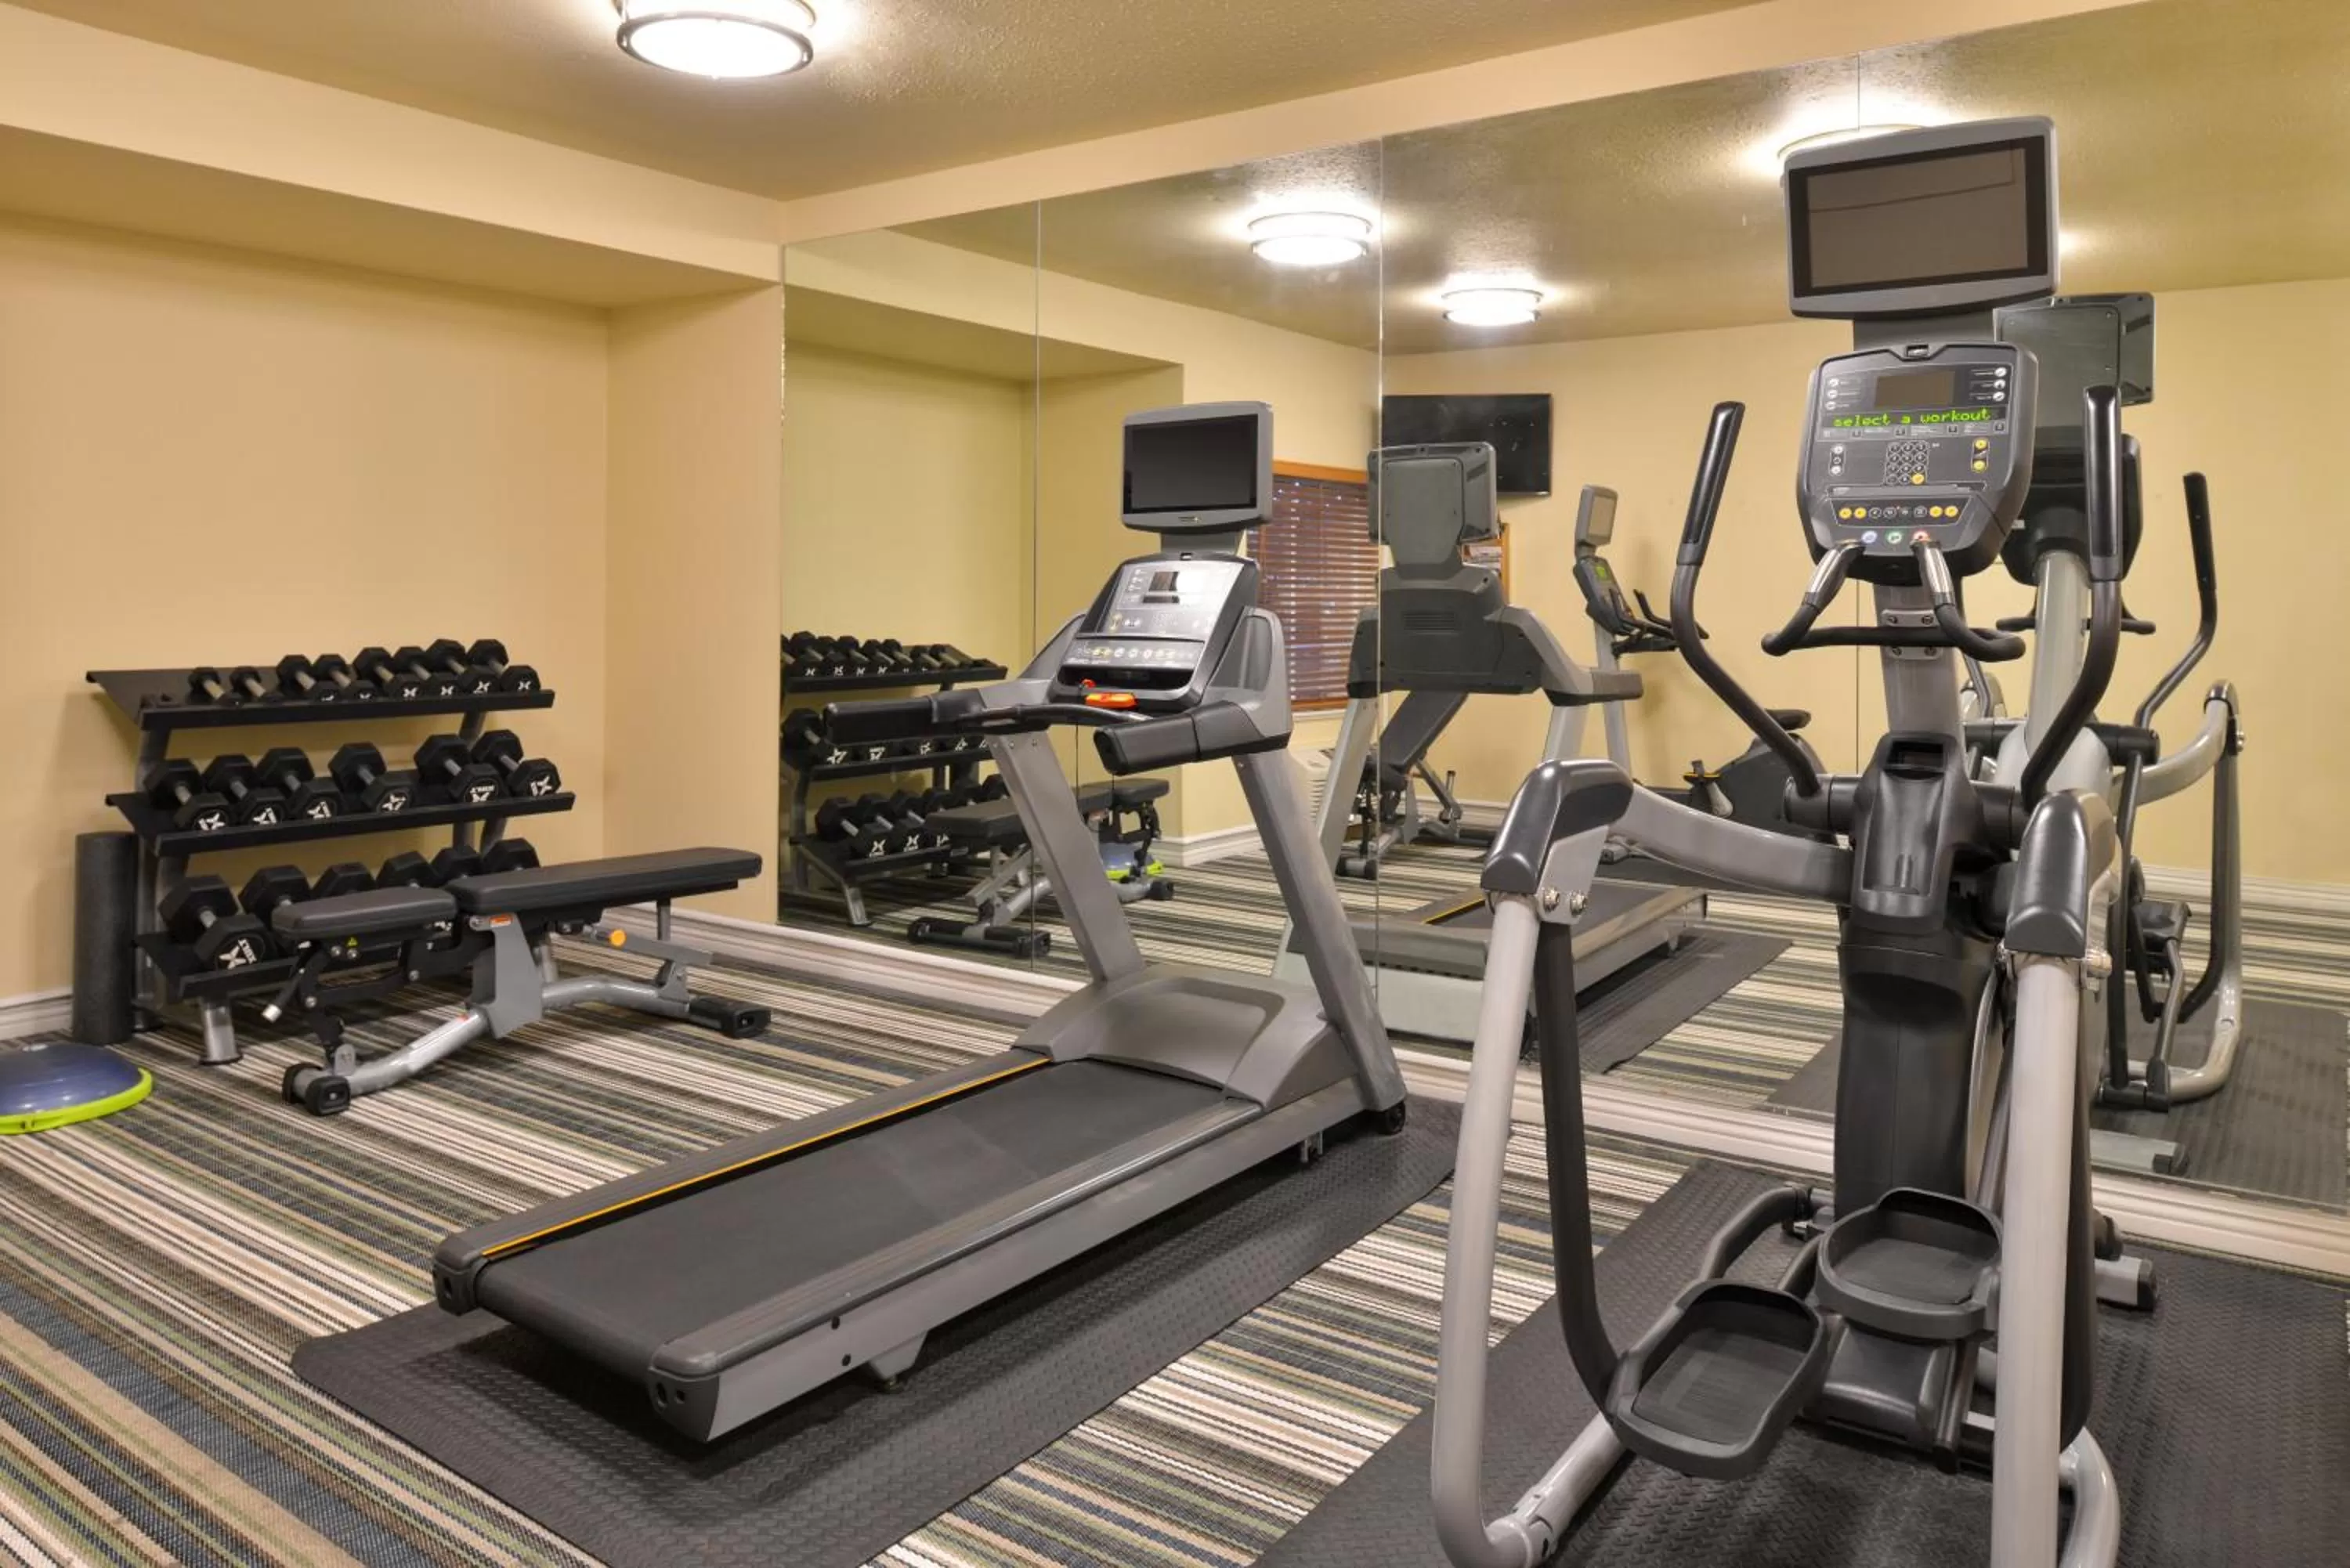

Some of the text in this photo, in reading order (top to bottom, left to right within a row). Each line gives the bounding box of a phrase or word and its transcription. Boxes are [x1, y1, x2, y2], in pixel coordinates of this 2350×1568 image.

[1833, 407, 1991, 427] select a workout
